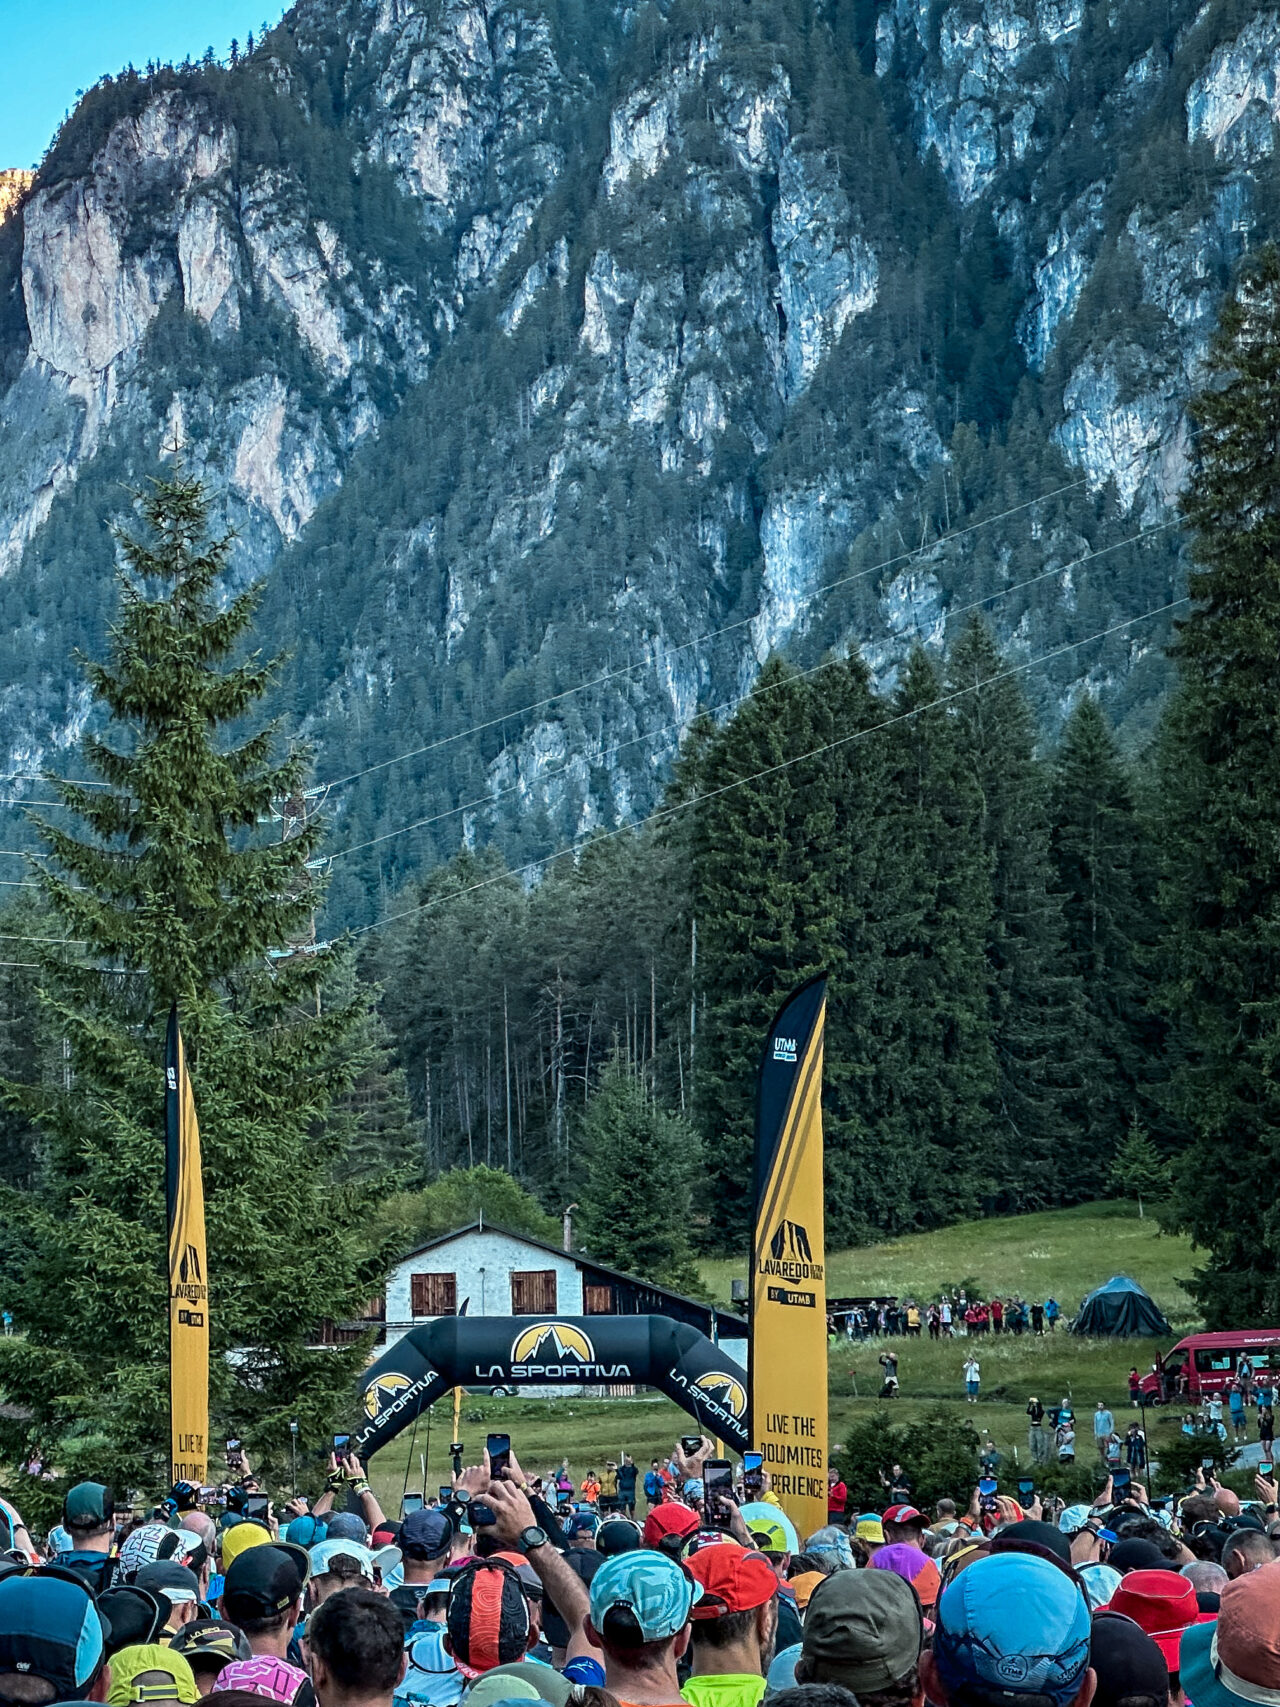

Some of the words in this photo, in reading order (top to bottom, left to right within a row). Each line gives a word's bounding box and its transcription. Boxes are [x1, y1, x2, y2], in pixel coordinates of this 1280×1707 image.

[759, 1259, 809, 1279] LAVAREDO
[770, 1289, 780, 1299] BY
[787, 1293, 811, 1305] UTMB
[475, 1365, 504, 1378] LA
[510, 1365, 631, 1378] SPORTIVA
[669, 1368, 688, 1388] LA
[356, 1426, 376, 1443] LA
[374, 1370, 439, 1428] SPORTIVA
[766, 1413, 789, 1434] LIVE
[792, 1416, 816, 1437] THE
[760, 1442, 822, 1469] DOLOMITES
[771, 1473, 824, 1500] PERIENCE
